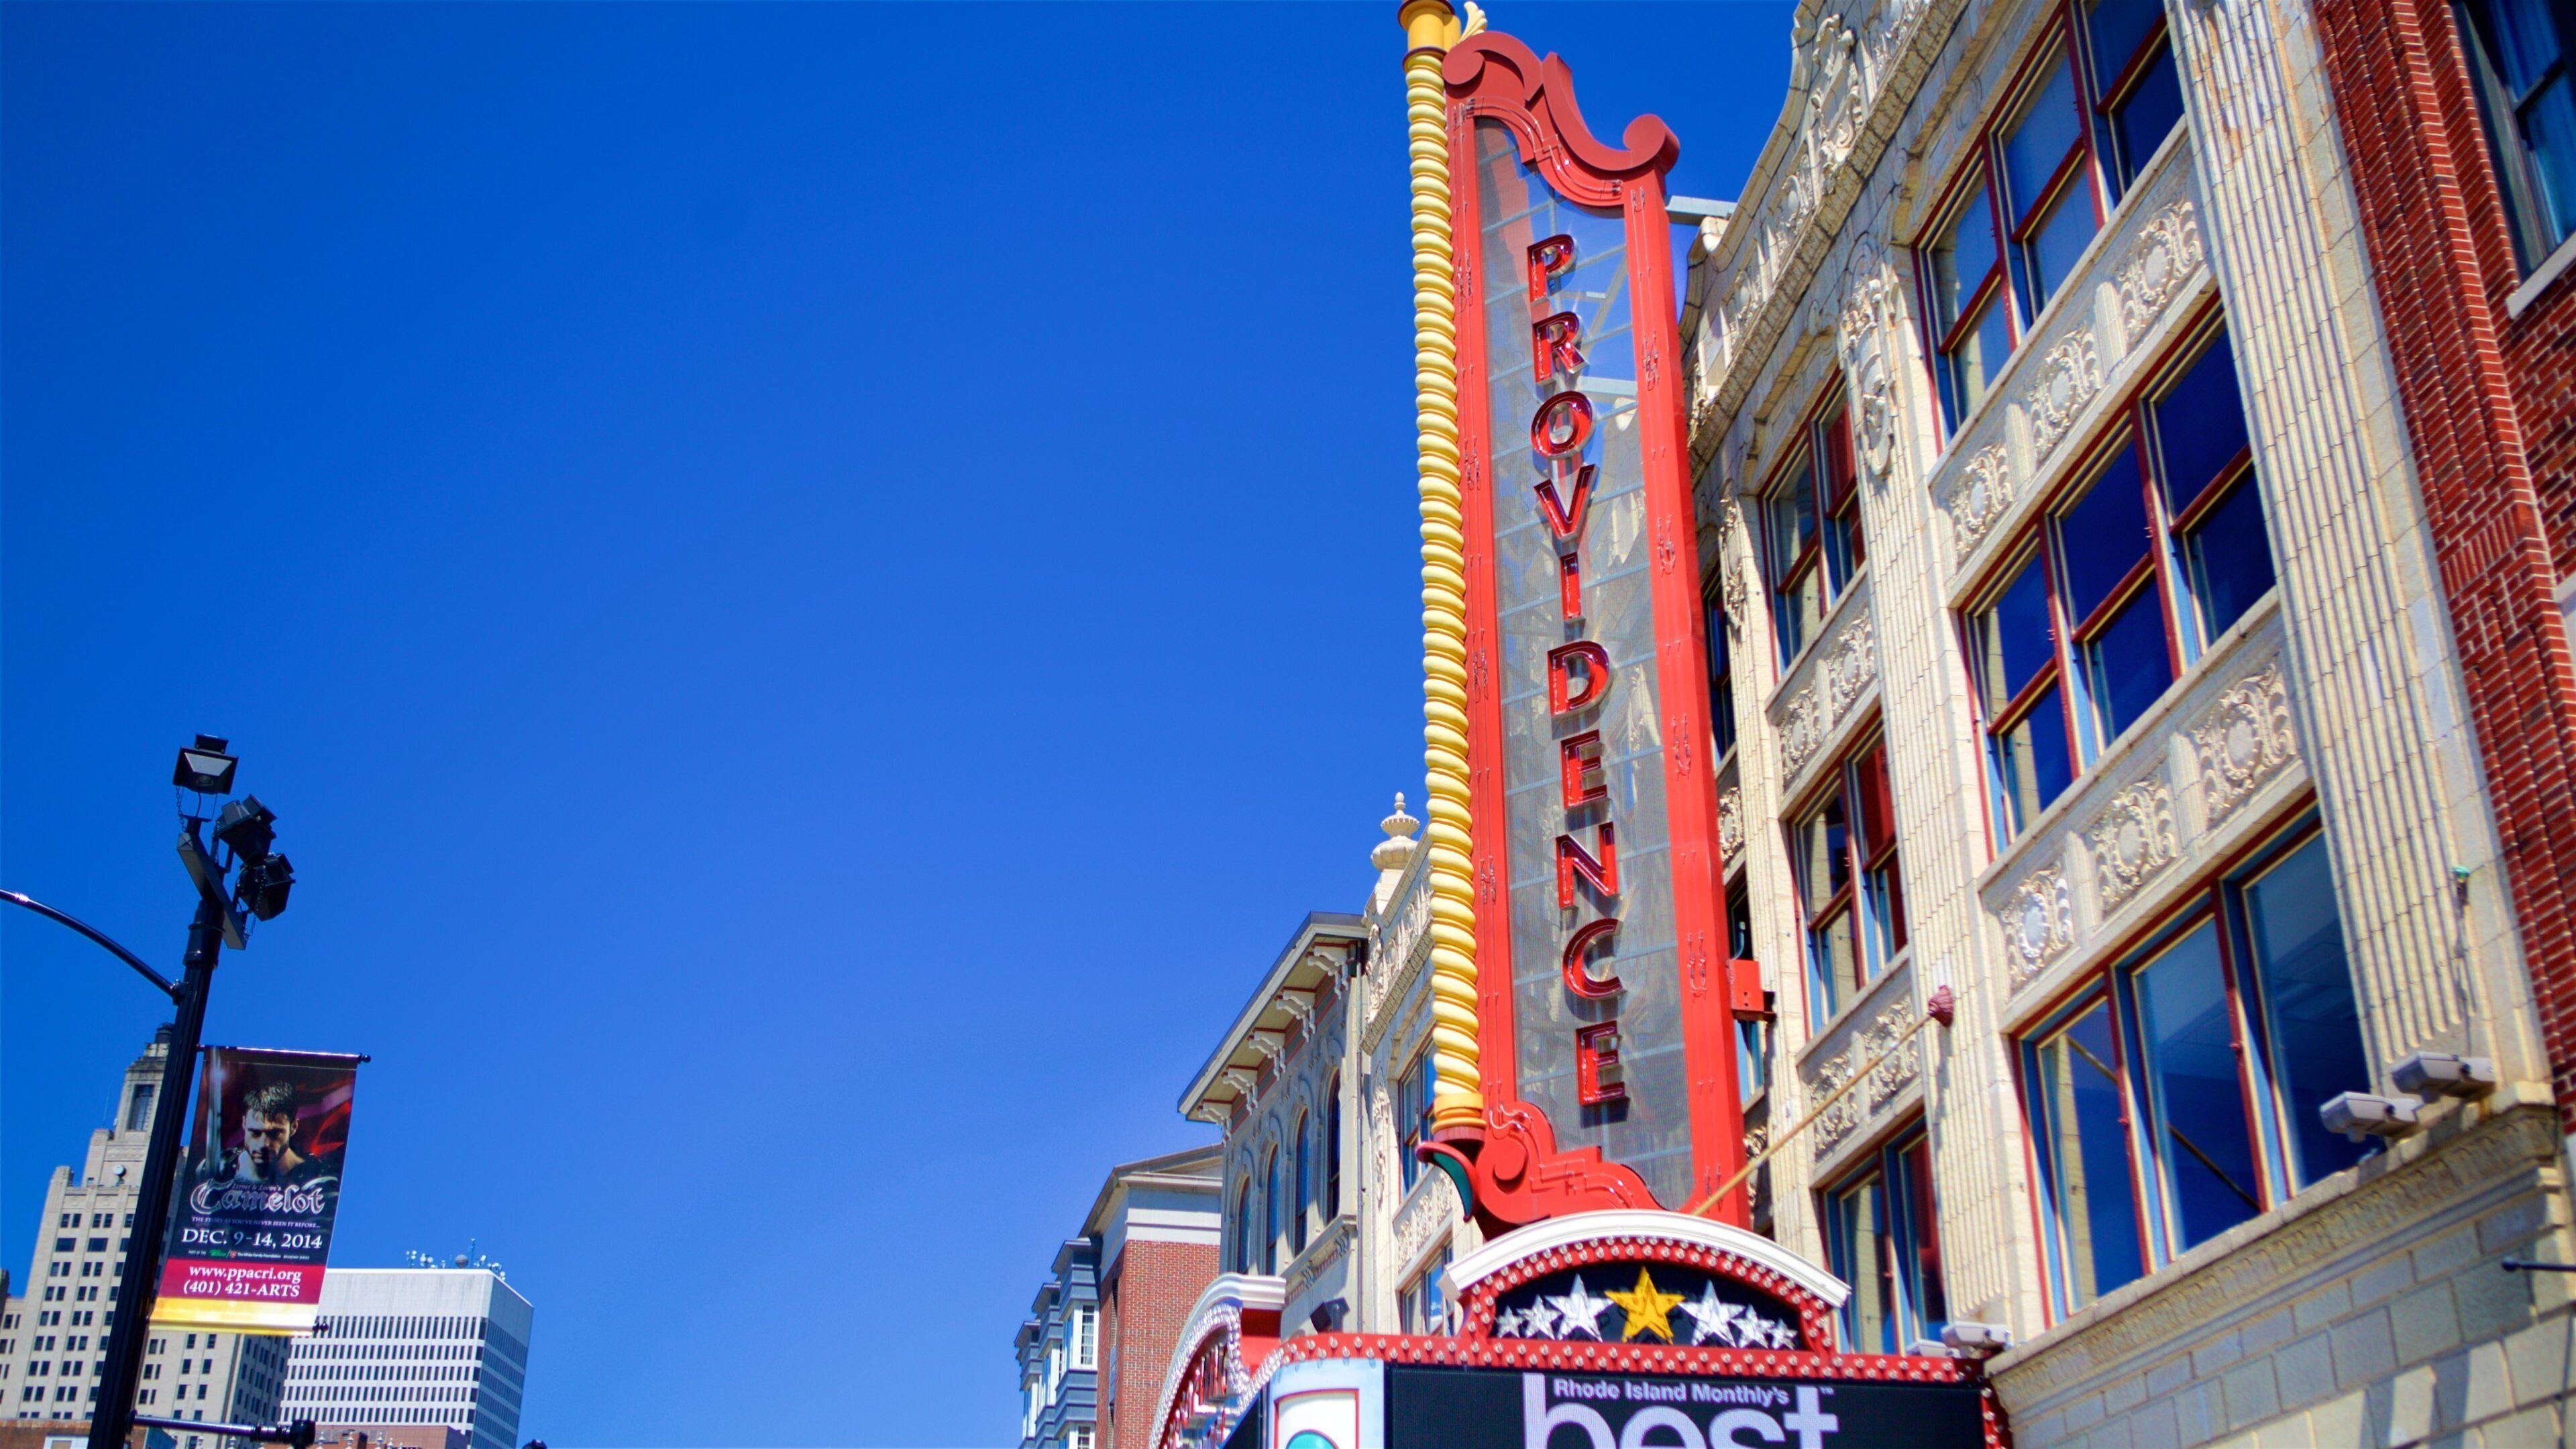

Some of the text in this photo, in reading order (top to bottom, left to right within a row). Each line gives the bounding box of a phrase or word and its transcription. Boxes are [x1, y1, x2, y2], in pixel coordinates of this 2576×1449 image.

[1527, 234, 1626, 1106] PROVIDENCE
[191, 1179, 325, 1214] Camelot
[181, 1228, 227, 1244] DEC.
[281, 1233, 322, 1248] 2014
[189, 1266, 302, 1284] www.ppacri.org
[183, 1279, 301, 1297] (401) 421-ARTS
[1553, 1377, 1790, 1408] Rhode Island Monthly's
